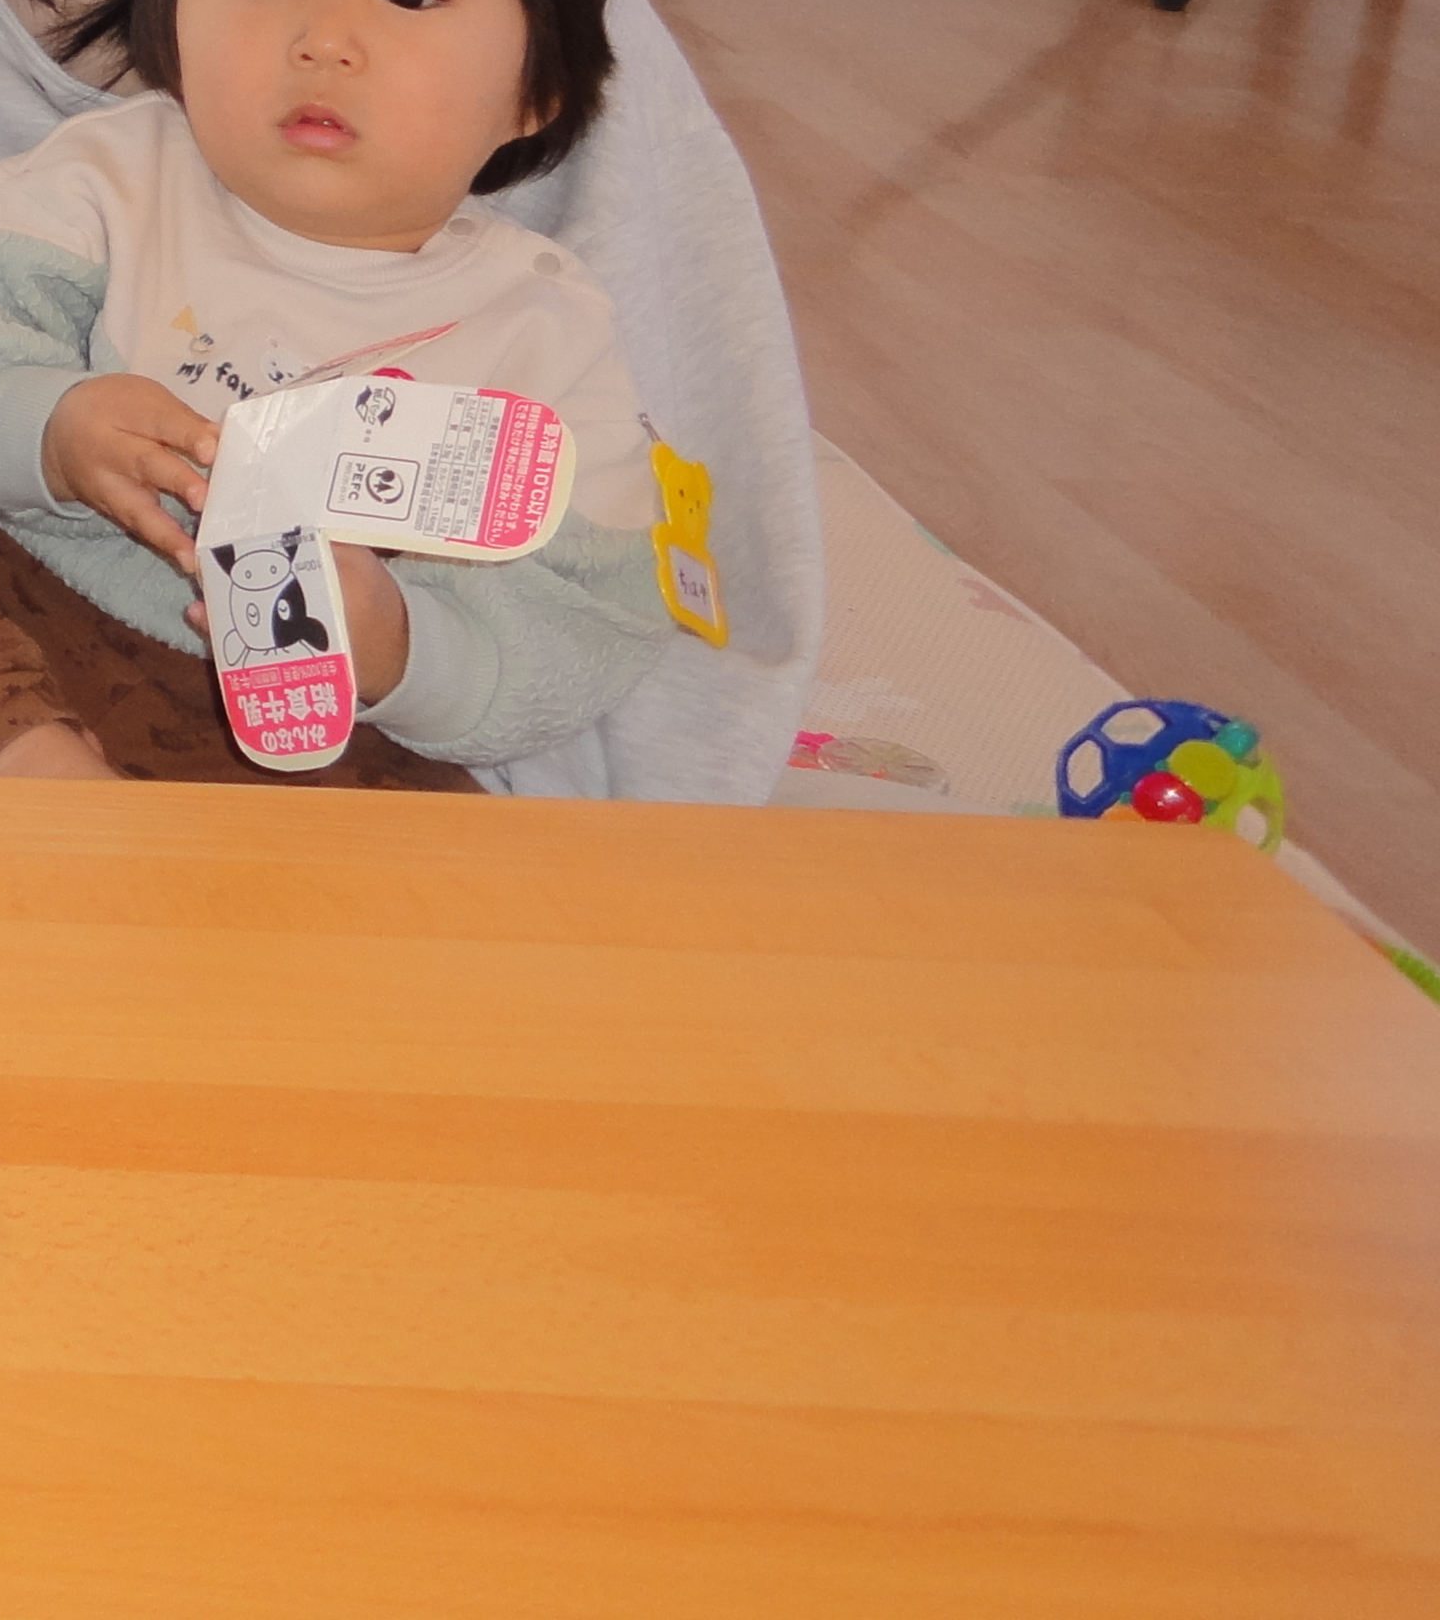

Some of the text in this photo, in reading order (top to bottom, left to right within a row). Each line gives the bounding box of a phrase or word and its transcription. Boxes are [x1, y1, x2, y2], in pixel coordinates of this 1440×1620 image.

[177, 362, 207, 384] my
[348, 463, 366, 500] PEFC
[524, 423, 560, 530] 要冷蔵10℃以下
[238, 682, 339, 727] 給食牛乳
[261, 723, 327, 753] みんなの
